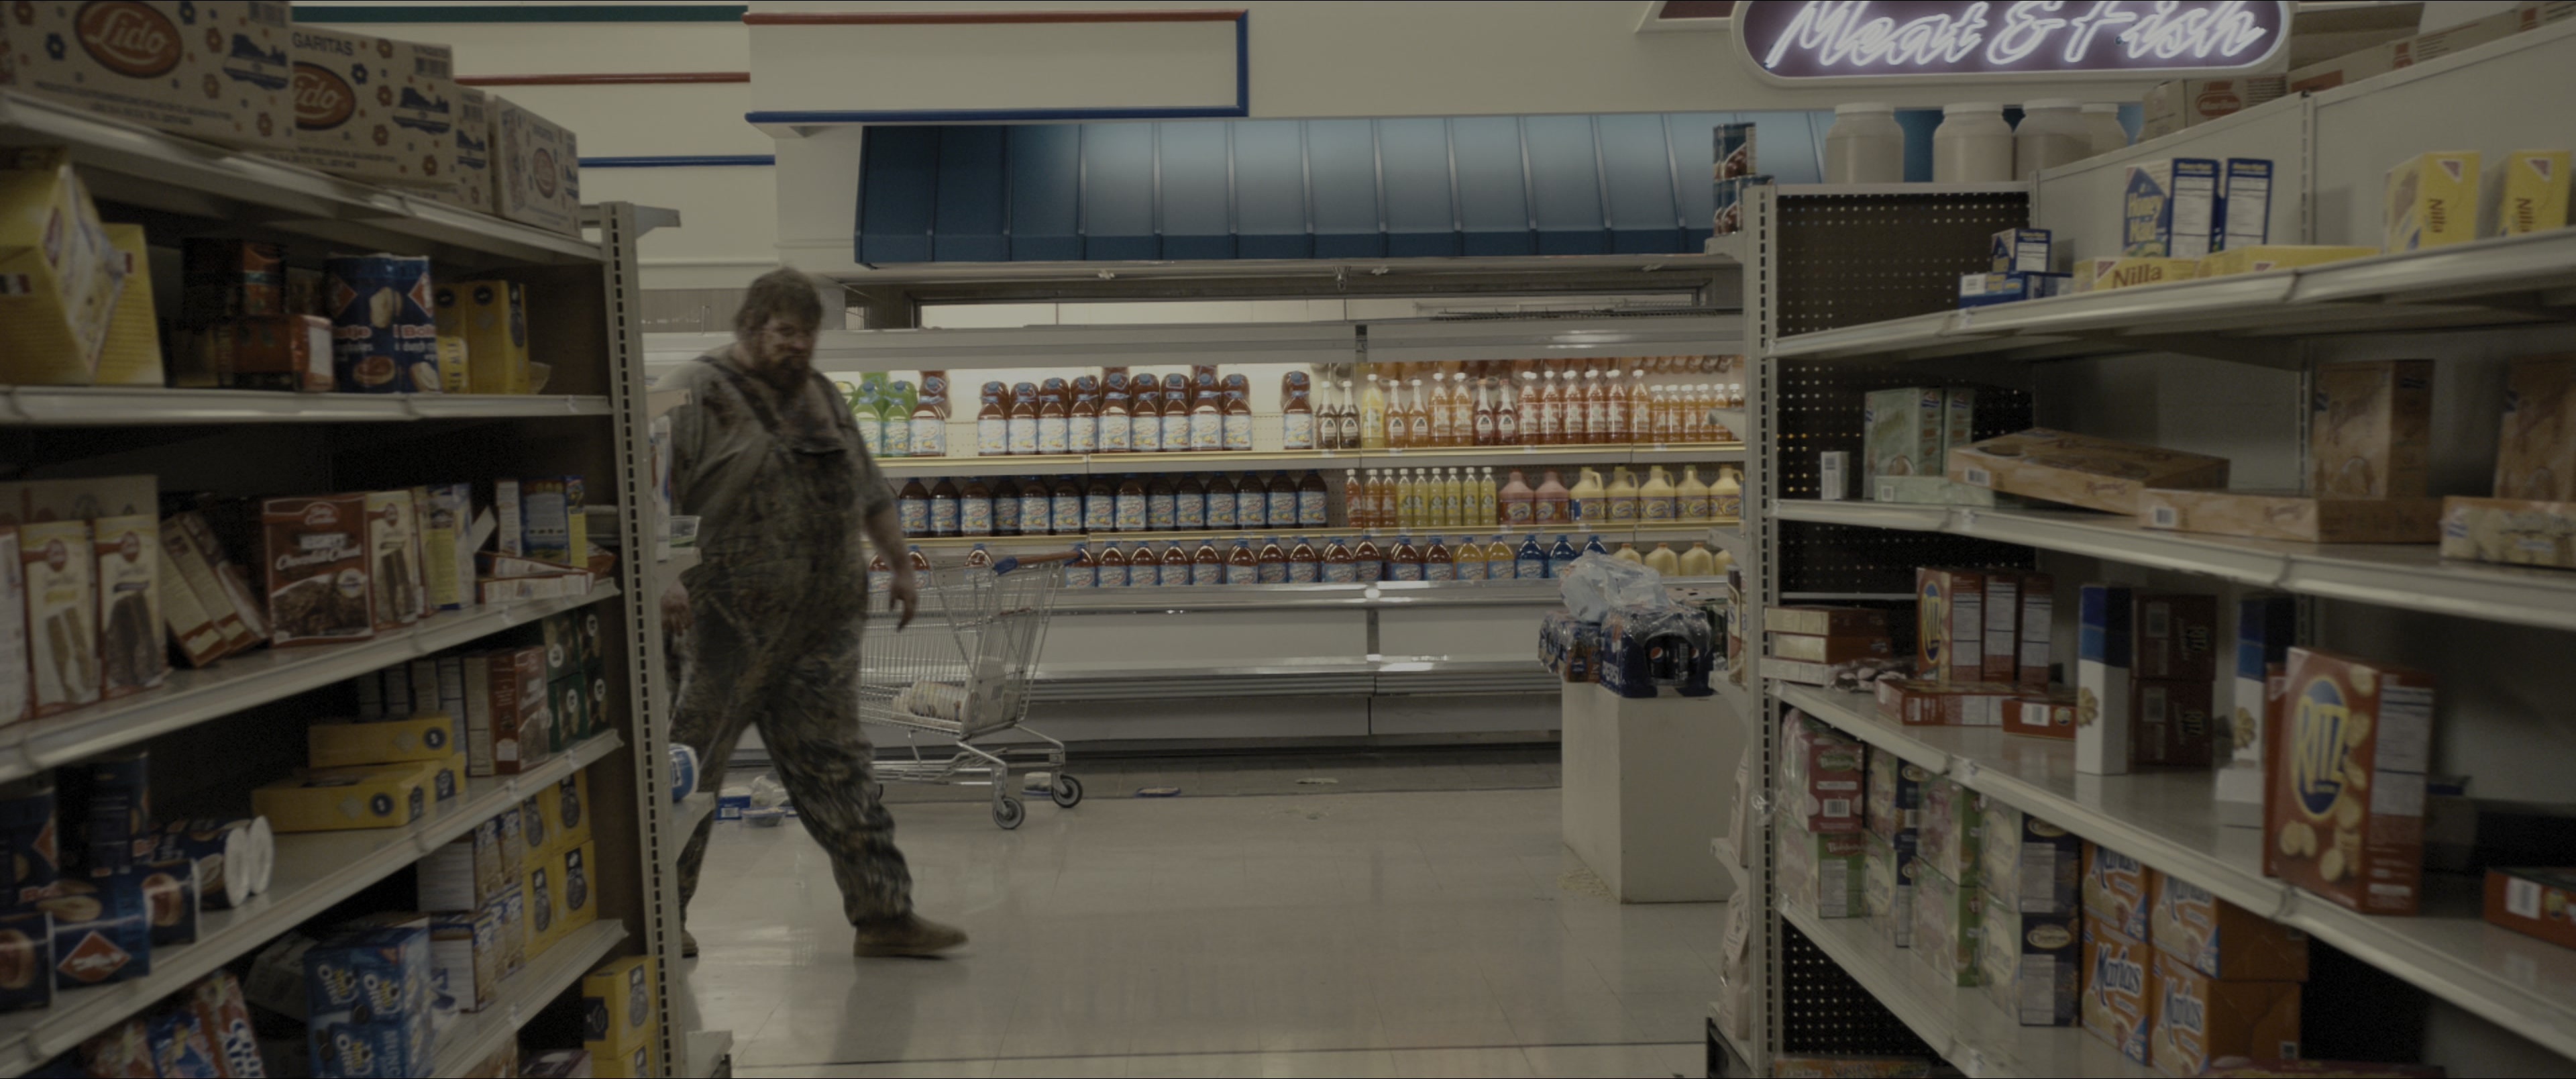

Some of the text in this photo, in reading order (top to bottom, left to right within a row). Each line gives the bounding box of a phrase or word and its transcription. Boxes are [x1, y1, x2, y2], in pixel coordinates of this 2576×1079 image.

[85, 8, 166, 65] Lido
[1764, 1, 1988, 68] Meat
[1986, 1, 2065, 64] &
[2113, 264, 2163, 288] Nilla
[1921, 593, 1942, 650] RITZ
[2296, 695, 2350, 795] RITZ
